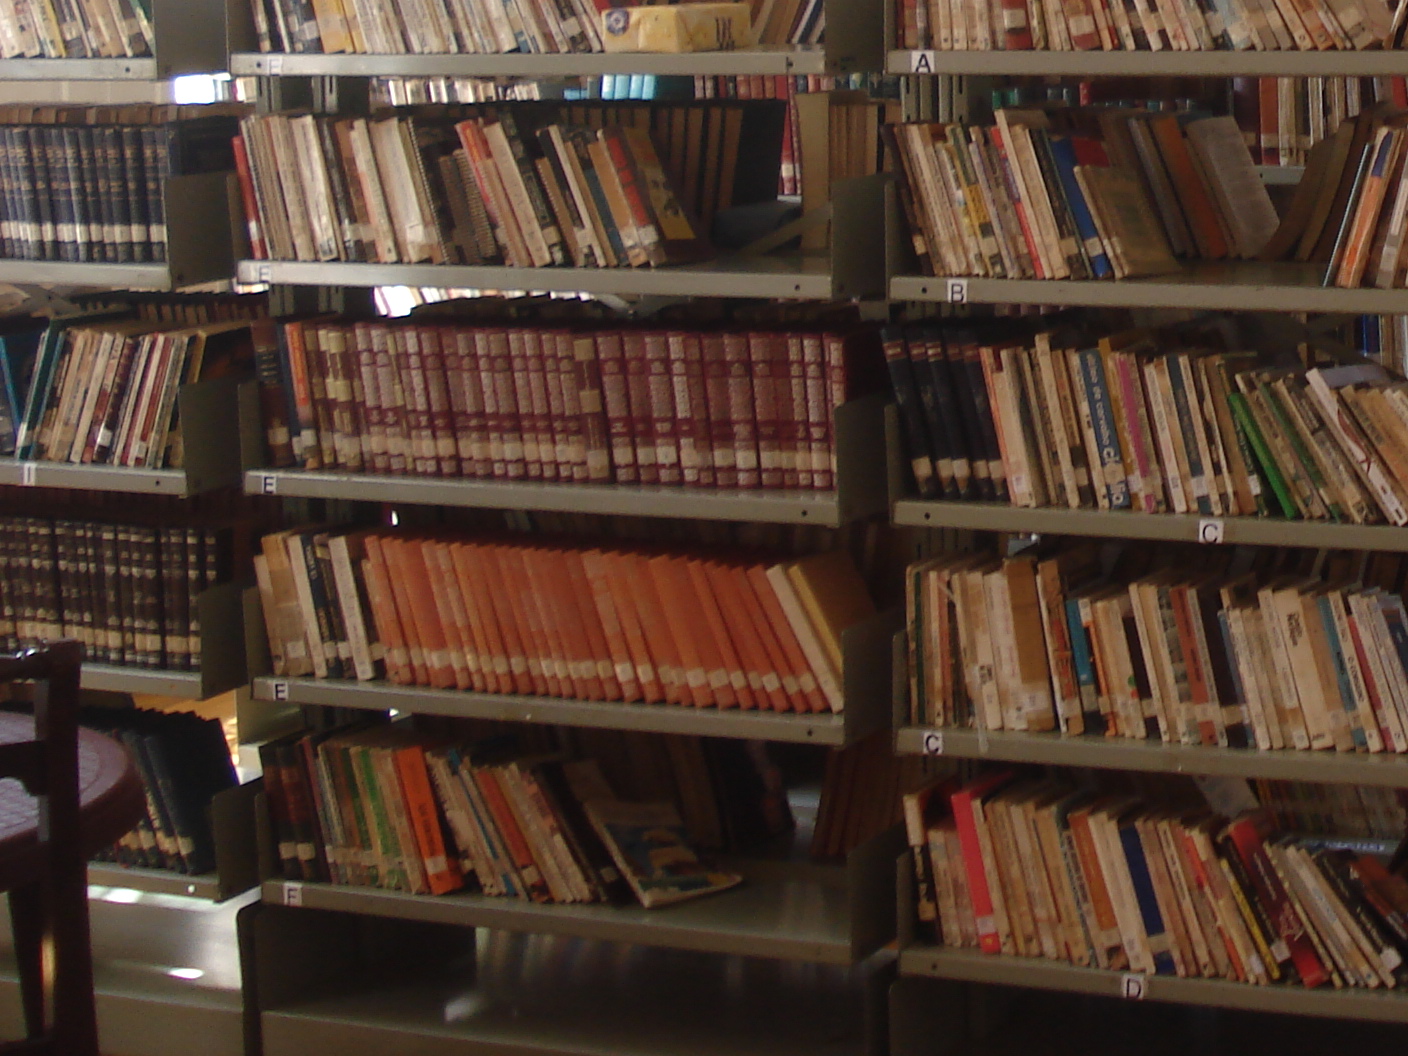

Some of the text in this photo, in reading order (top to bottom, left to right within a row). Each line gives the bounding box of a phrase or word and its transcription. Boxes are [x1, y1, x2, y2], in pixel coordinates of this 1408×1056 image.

[915, 53, 931, 73] A
[950, 284, 964, 303] B
[264, 476, 275, 494] E
[1203, 524, 1218, 544] C
[275, 684, 286, 701] E
[925, 734, 940, 753] C
[1126, 978, 1141, 998] D
